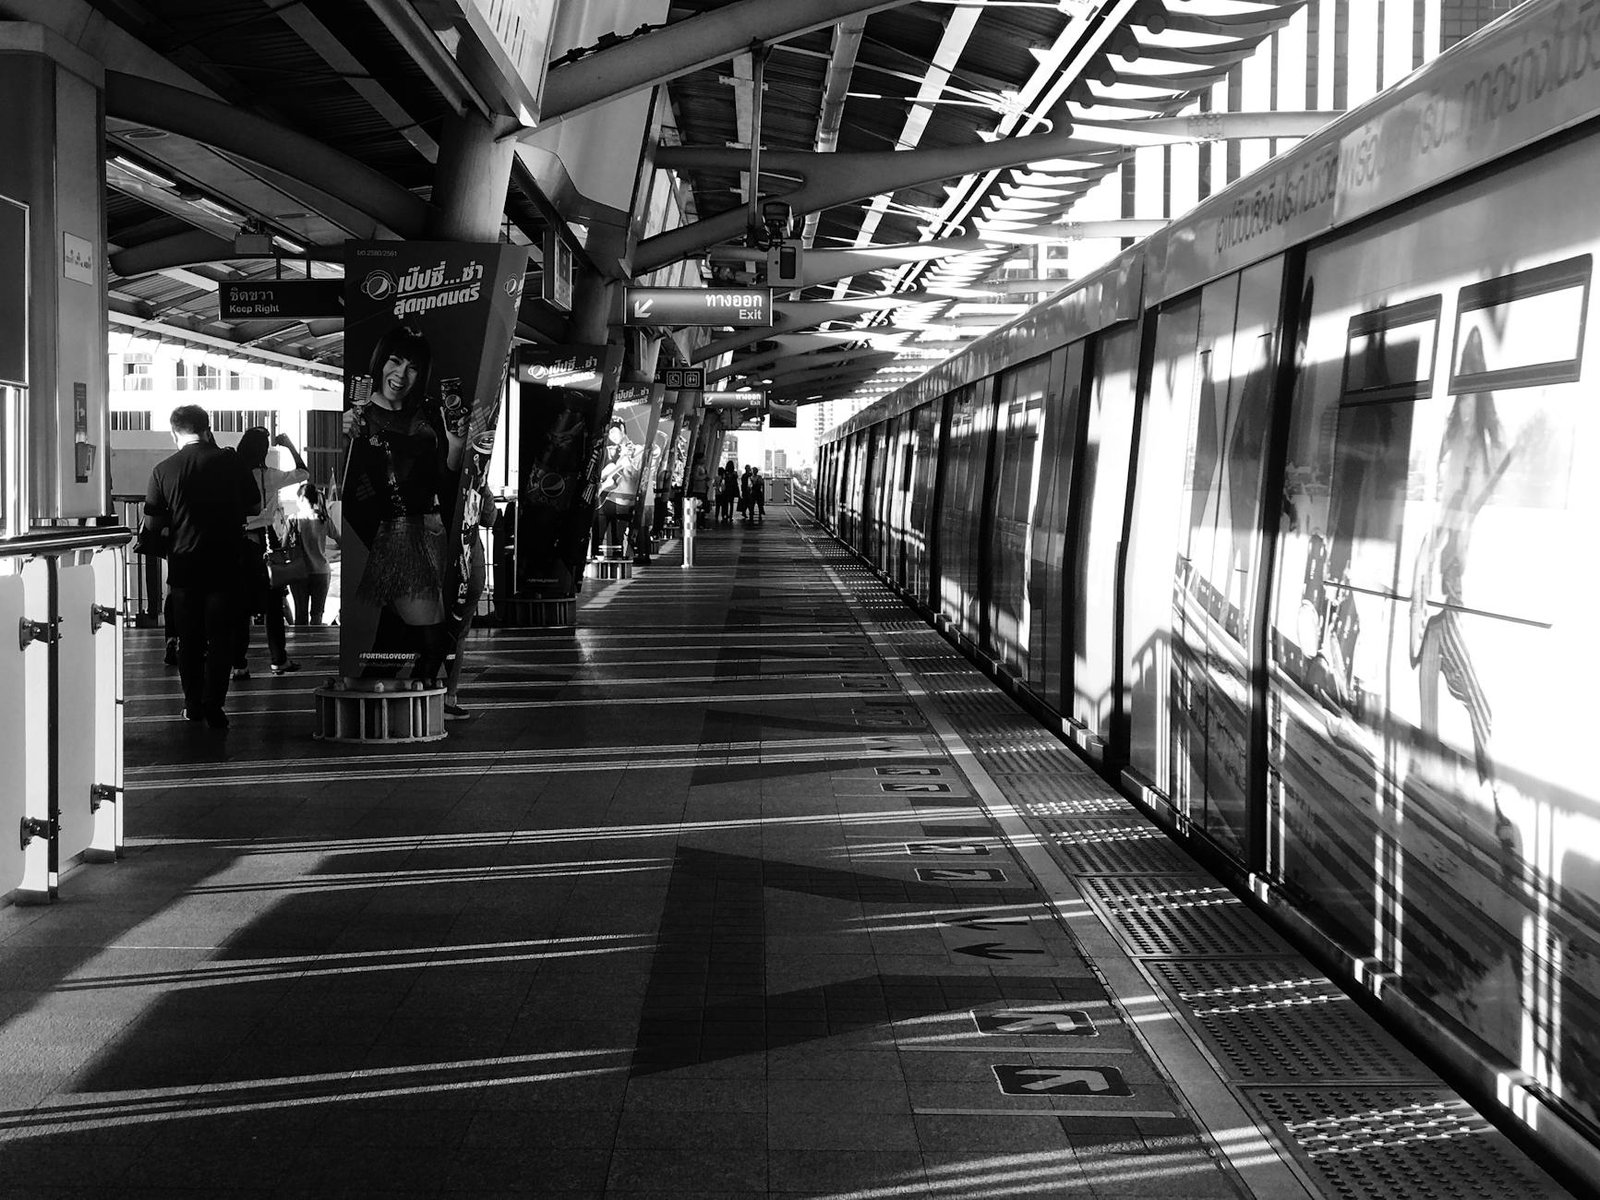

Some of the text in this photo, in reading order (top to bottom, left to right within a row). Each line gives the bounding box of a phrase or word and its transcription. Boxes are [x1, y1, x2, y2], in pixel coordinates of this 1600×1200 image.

[229, 286, 274, 302] ชิดขวา
[705, 294, 762, 307] ทางออก
[229, 304, 279, 315] Keep Right
[739, 309, 761, 320] Exit
